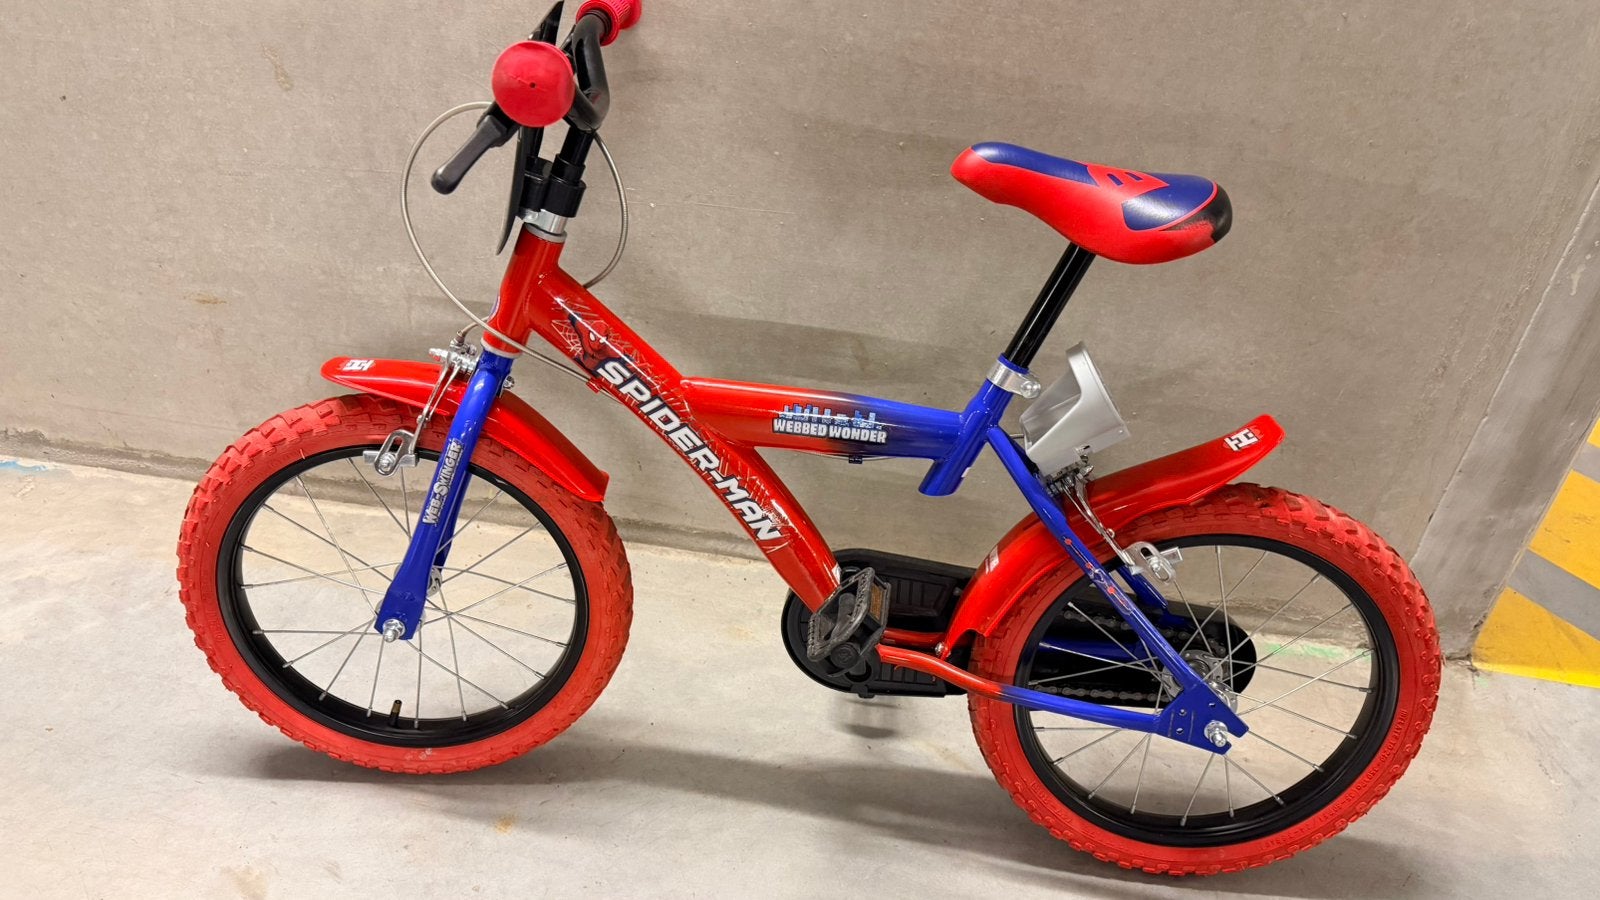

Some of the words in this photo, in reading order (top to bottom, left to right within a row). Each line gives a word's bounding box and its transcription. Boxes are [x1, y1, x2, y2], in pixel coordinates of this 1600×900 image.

[596, 360, 782, 541] SPIDER-MAN
[773, 418, 828, 437] WEBBED
[828, 424, 888, 444] WONDER
[422, 440, 462, 524] WEB-SWINGER
